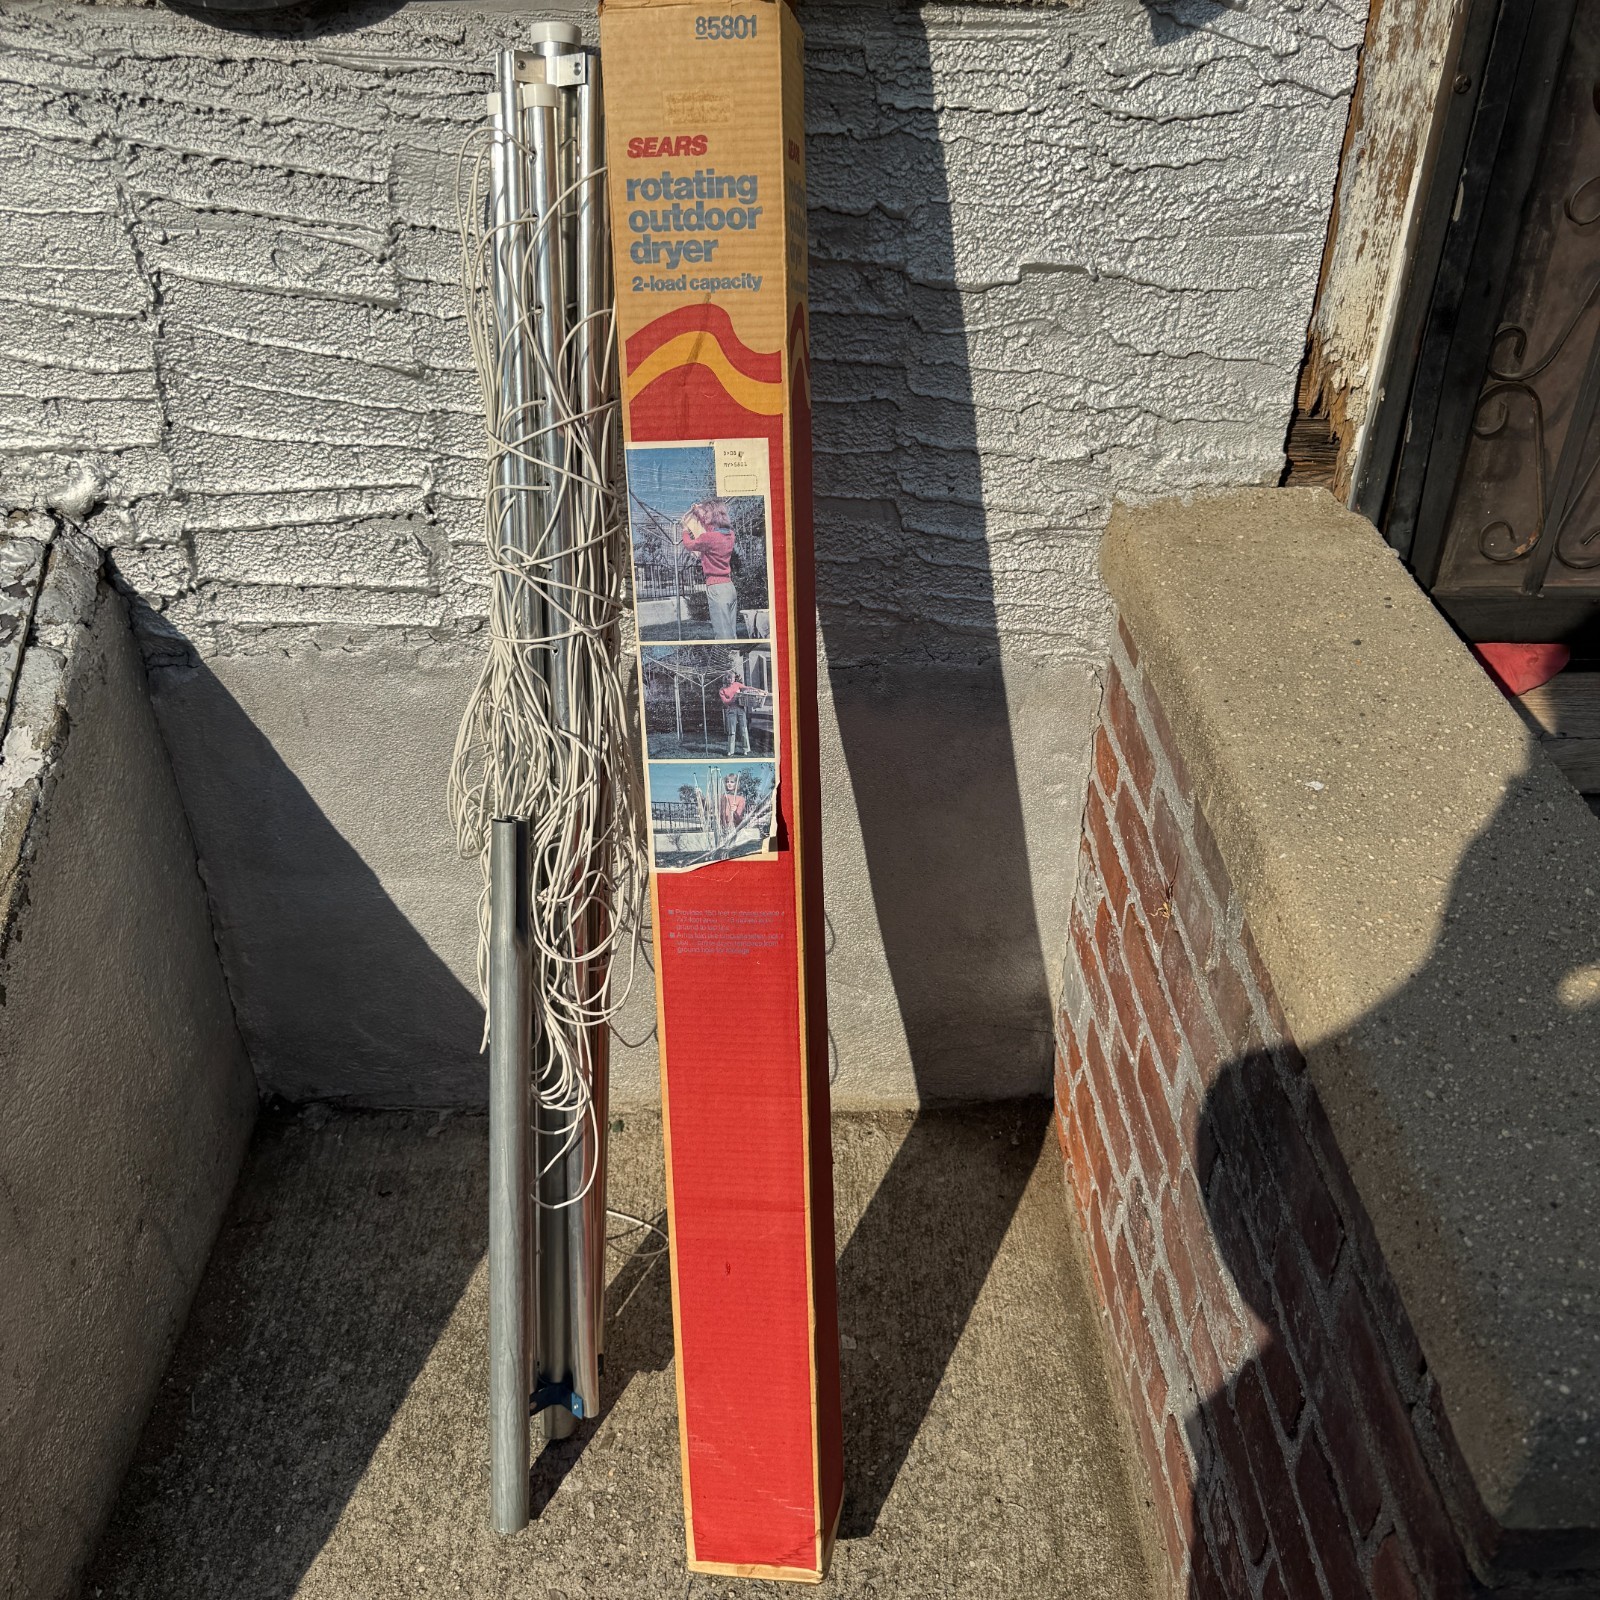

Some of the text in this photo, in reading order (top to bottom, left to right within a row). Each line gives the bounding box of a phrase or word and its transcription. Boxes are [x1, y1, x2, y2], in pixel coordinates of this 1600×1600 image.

[695, 15, 757, 40] 85801
[627, 135, 708, 158] SEARS
[626, 168, 758, 204] rotating
[628, 201, 763, 233] outdoor
[629, 234, 719, 269] dryer
[632, 273, 763, 293] 2-load capacity
